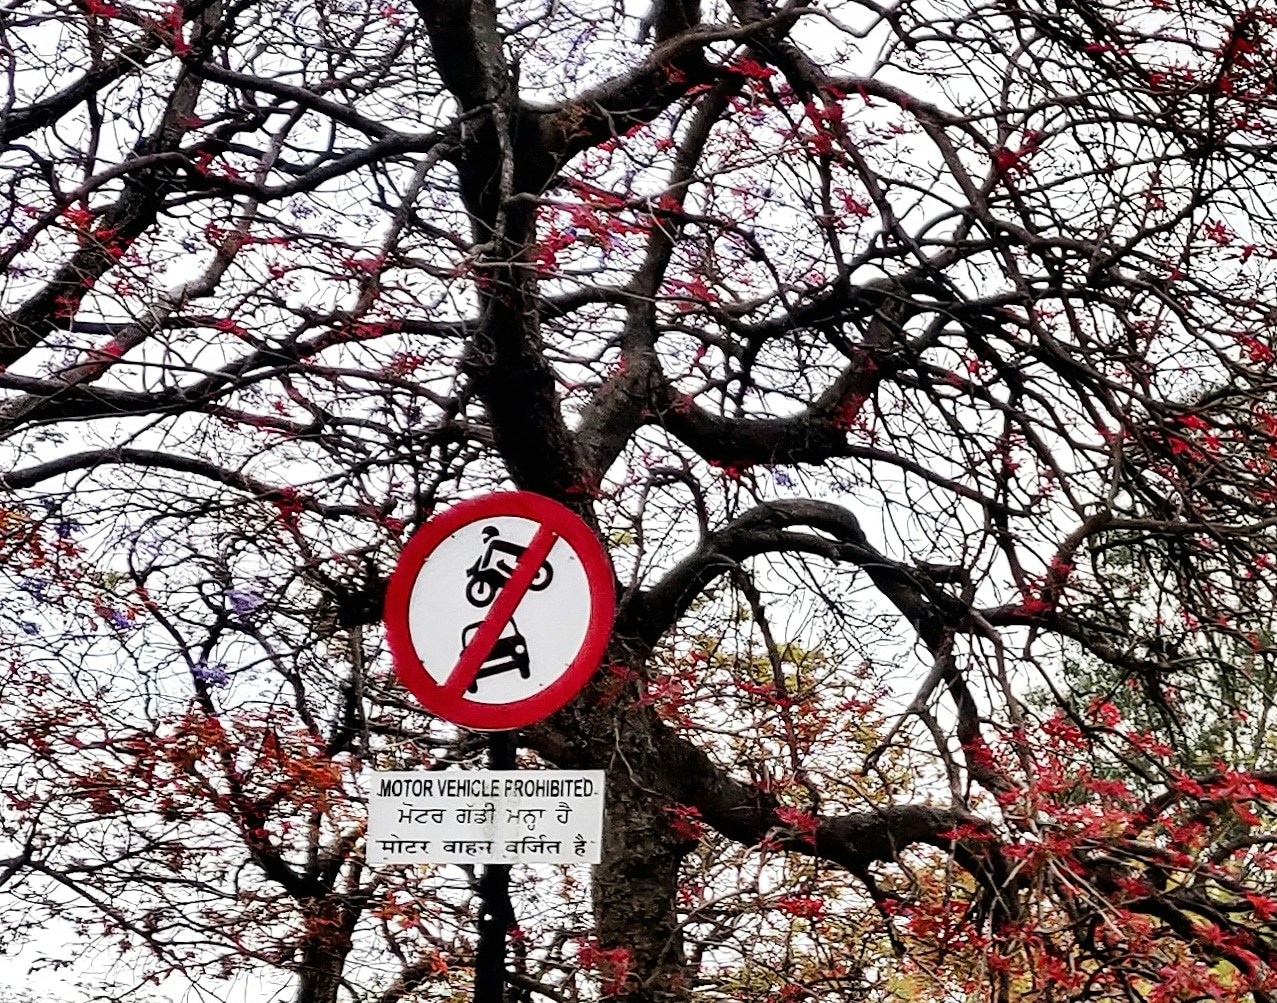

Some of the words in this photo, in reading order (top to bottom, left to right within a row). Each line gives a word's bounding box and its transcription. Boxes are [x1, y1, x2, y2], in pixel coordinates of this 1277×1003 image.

[380, 779, 433, 797] MOTOR
[438, 779, 500, 797] VEHICLE
[504, 778, 593, 797] PROHIBITED
[375, 834, 431, 854] मोटर
